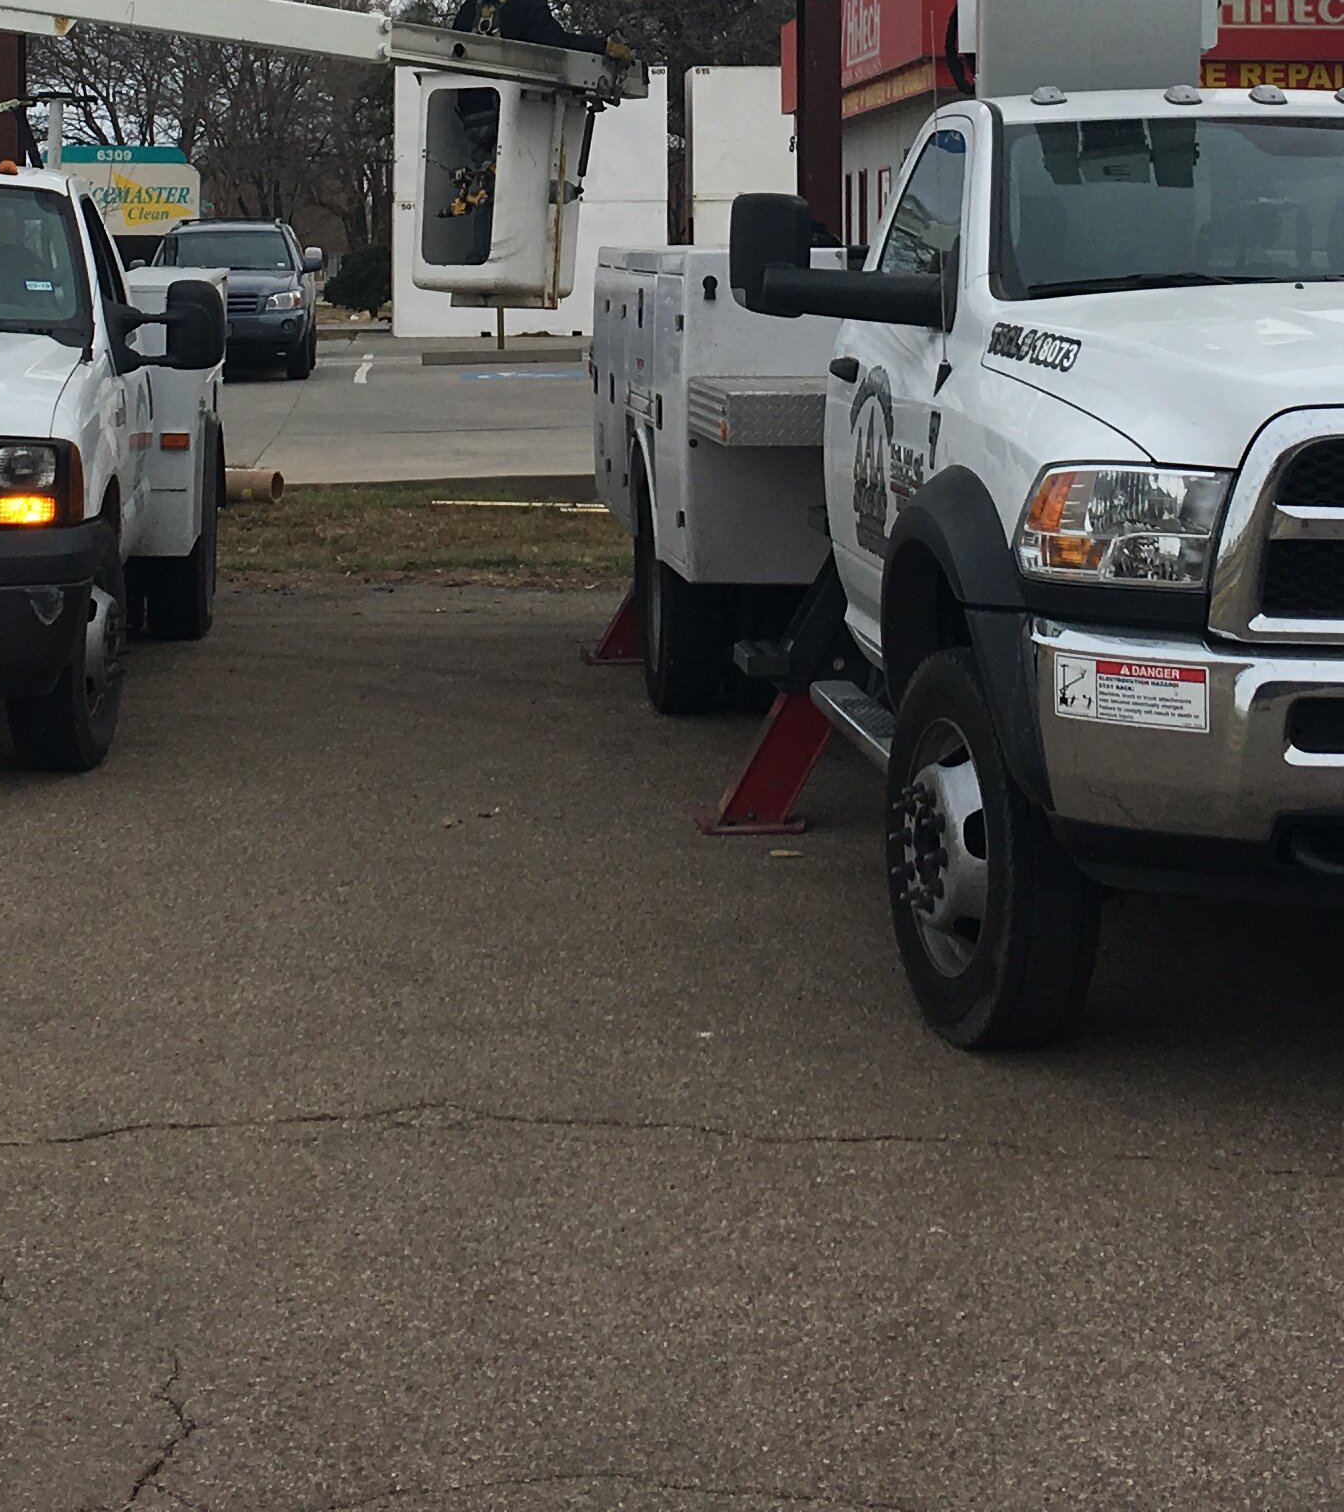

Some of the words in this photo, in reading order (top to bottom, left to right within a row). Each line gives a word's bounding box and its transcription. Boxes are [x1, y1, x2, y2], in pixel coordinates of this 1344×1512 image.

[96, 149, 133, 161] 6309
[127, 207, 170, 221] Clean
[1029, 332, 1081, 372] 18073
[1132, 667, 1180, 679] DANGER
